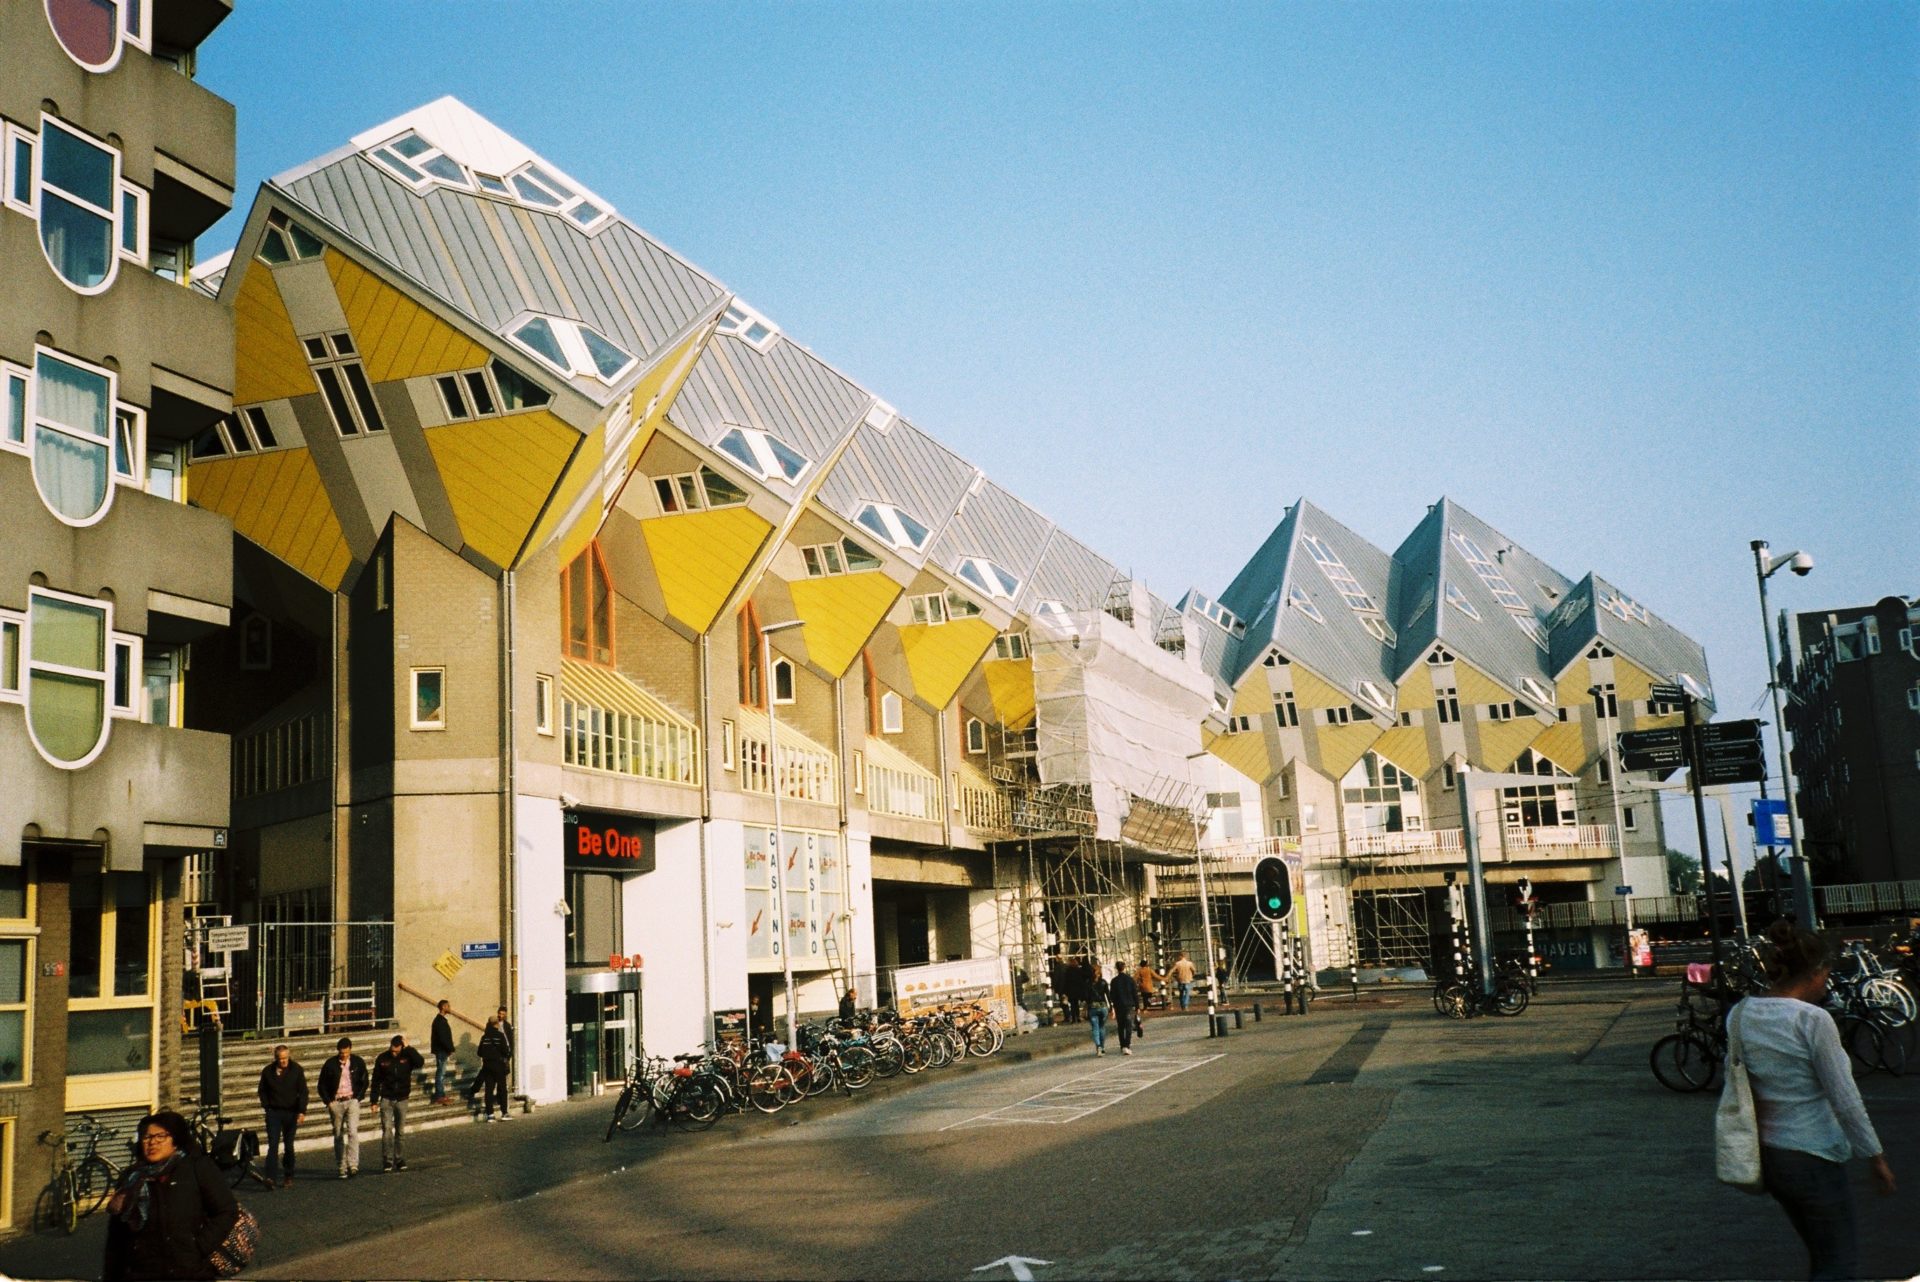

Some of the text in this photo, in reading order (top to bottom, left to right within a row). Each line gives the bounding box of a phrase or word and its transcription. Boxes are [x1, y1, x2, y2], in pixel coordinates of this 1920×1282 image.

[578, 826, 642, 858] Be One
[769, 832, 779, 955] CASINO
[807, 836, 817, 954] CASINO
[609, 953, 630, 969] Be
